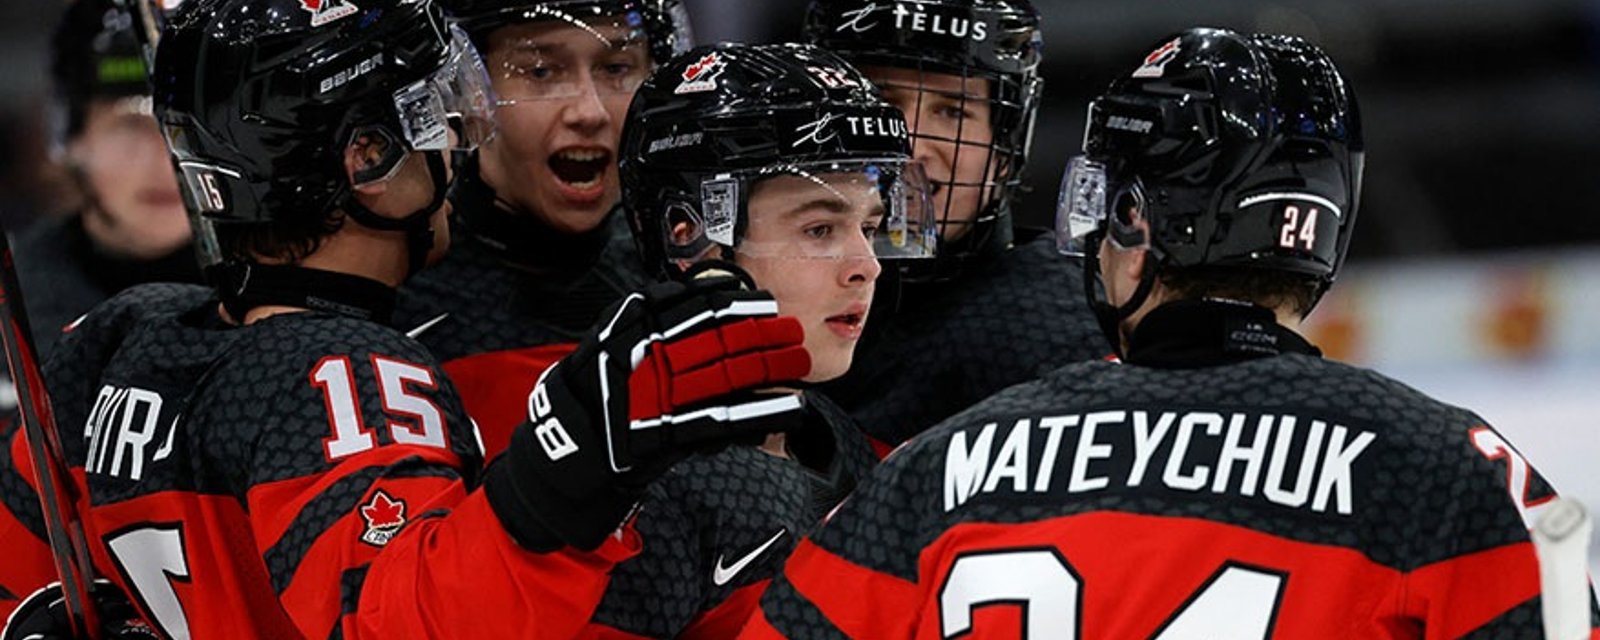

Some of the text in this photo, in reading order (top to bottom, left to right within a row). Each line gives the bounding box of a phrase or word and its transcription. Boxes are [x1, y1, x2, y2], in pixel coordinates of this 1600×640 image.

[892, 4, 987, 41] TELUS
[320, 53, 383, 93] BAUER
[846, 116, 907, 139] TELUS
[197, 173, 223, 210] 15
[1280, 205, 1318, 250] 24
[309, 352, 450, 462] 15
[944, 410, 1375, 514] MATEYCHUK
